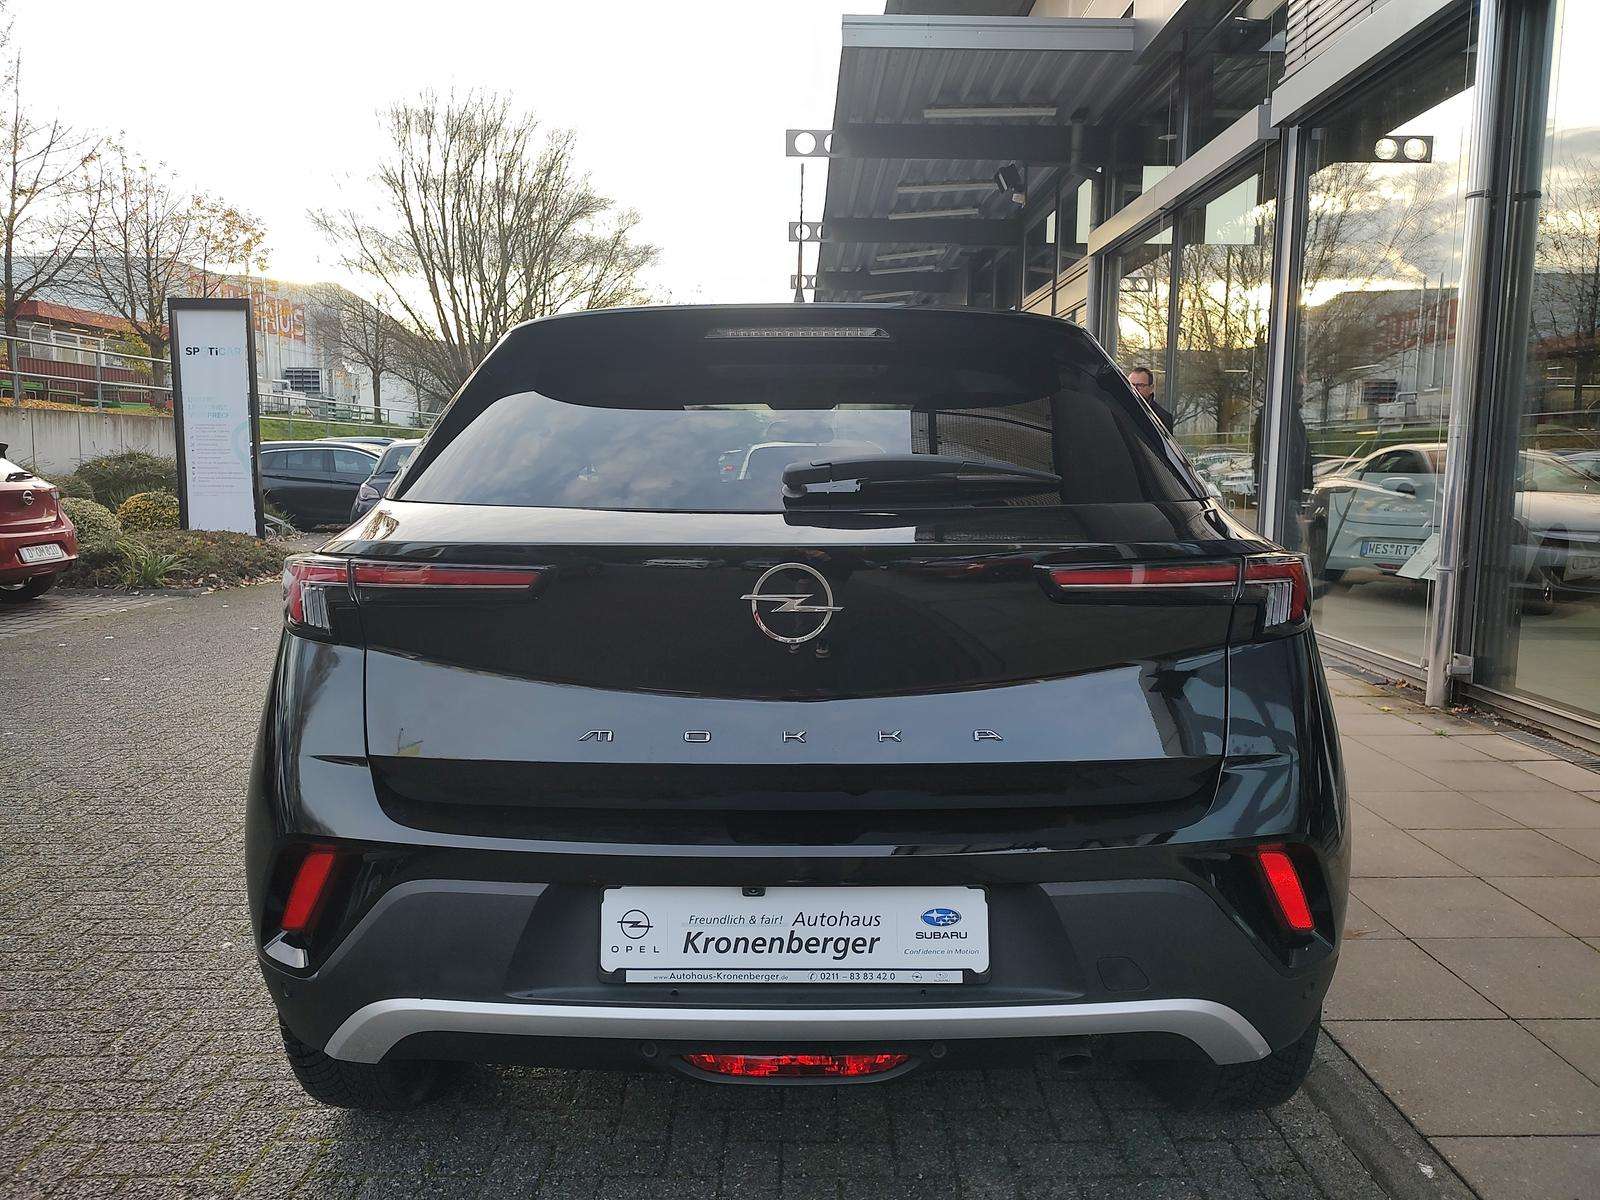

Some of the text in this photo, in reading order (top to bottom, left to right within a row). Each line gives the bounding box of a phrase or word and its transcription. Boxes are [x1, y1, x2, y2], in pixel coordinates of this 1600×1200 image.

[576, 728, 1004, 743] MOKKA
[688, 910, 882, 928] Freundlich & fair! Autohaus
[915, 931, 968, 940] SUBARU
[610, 945, 660, 954] OPEL
[682, 929, 881, 961] Kronenberger
[904, 947, 980, 956] Confidence in Motion
[819, 972, 840, 981] 0211
[849, 972, 860, 981] 83
[862, 972, 874, 981] 83
[876, 972, 888, 981] 42
[889, 972, 896, 981] 0
